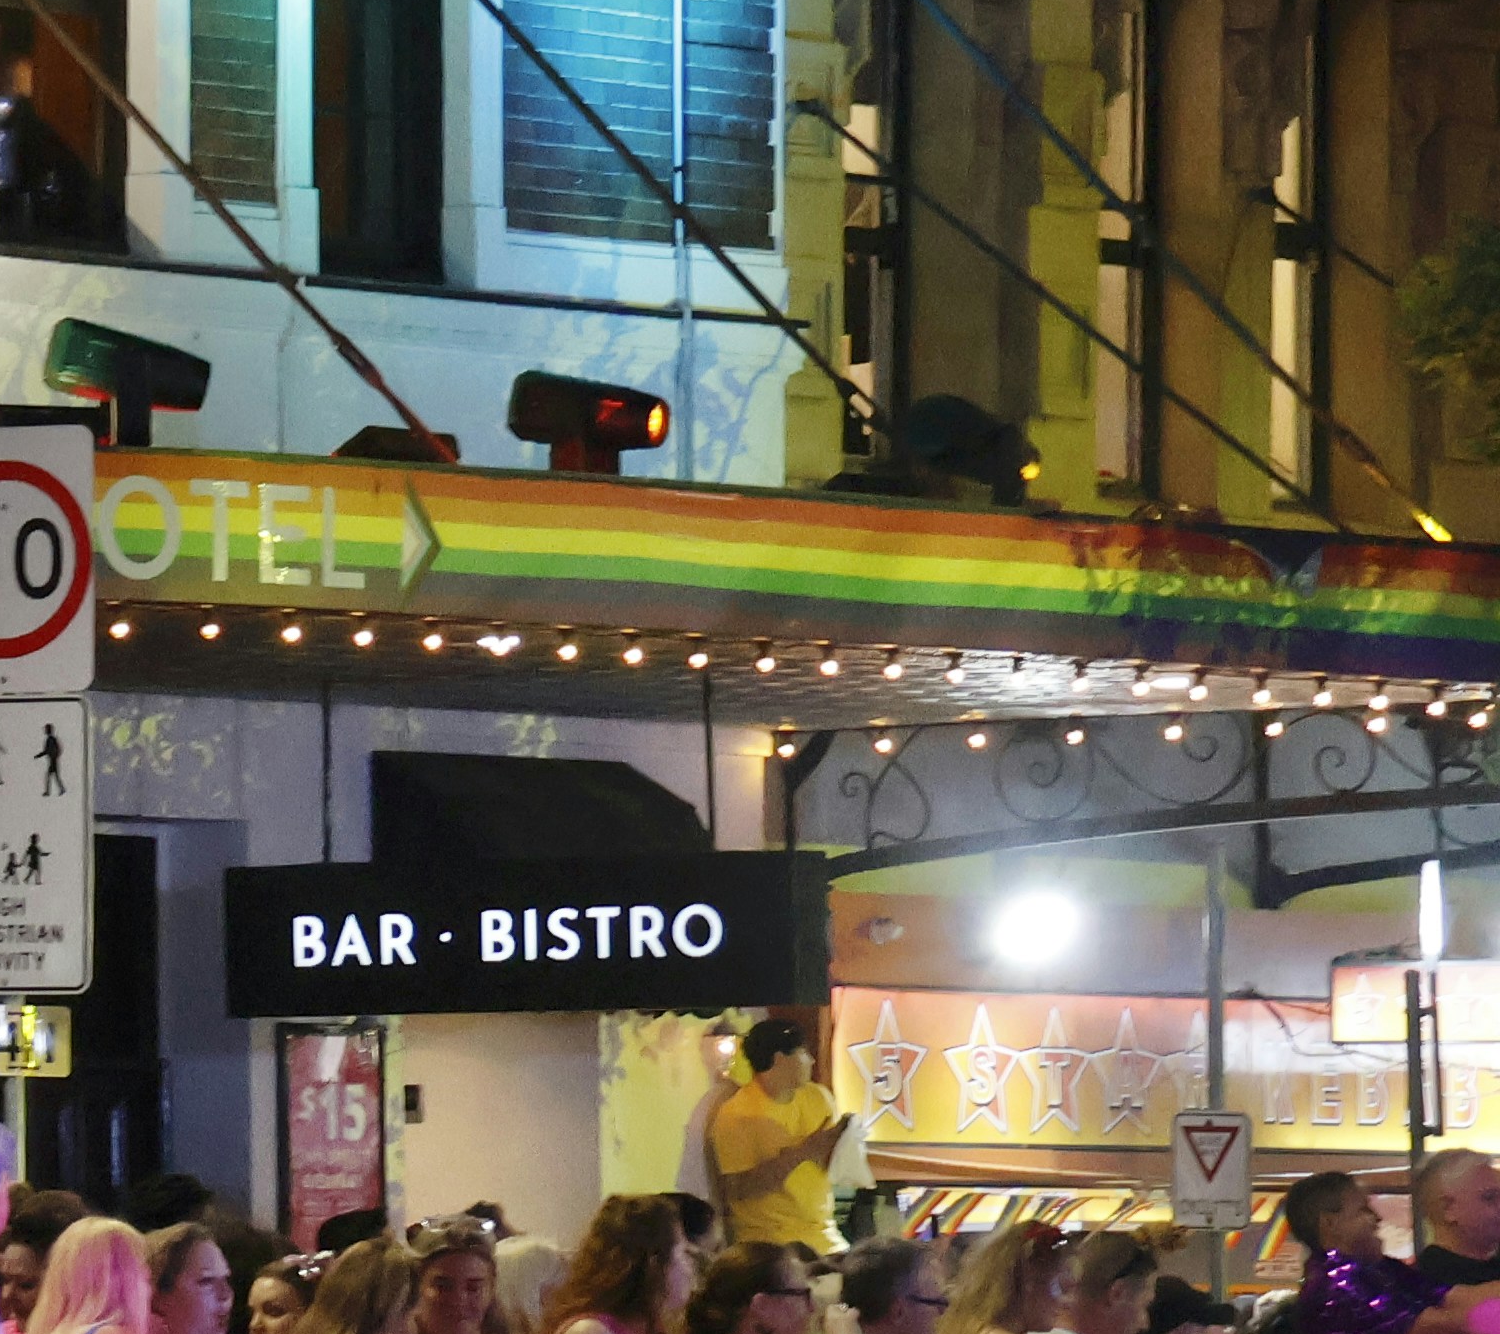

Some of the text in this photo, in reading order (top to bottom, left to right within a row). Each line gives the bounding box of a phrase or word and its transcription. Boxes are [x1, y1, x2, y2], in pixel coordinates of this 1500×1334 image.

[100, 475, 366, 589] OTEL
[291, 903, 725, 968] BAR BISTRO
[294, 1081, 368, 1143] $15
[969, 1045, 1210, 1111] STAR
[1262, 1059, 1480, 1127] KEBB
